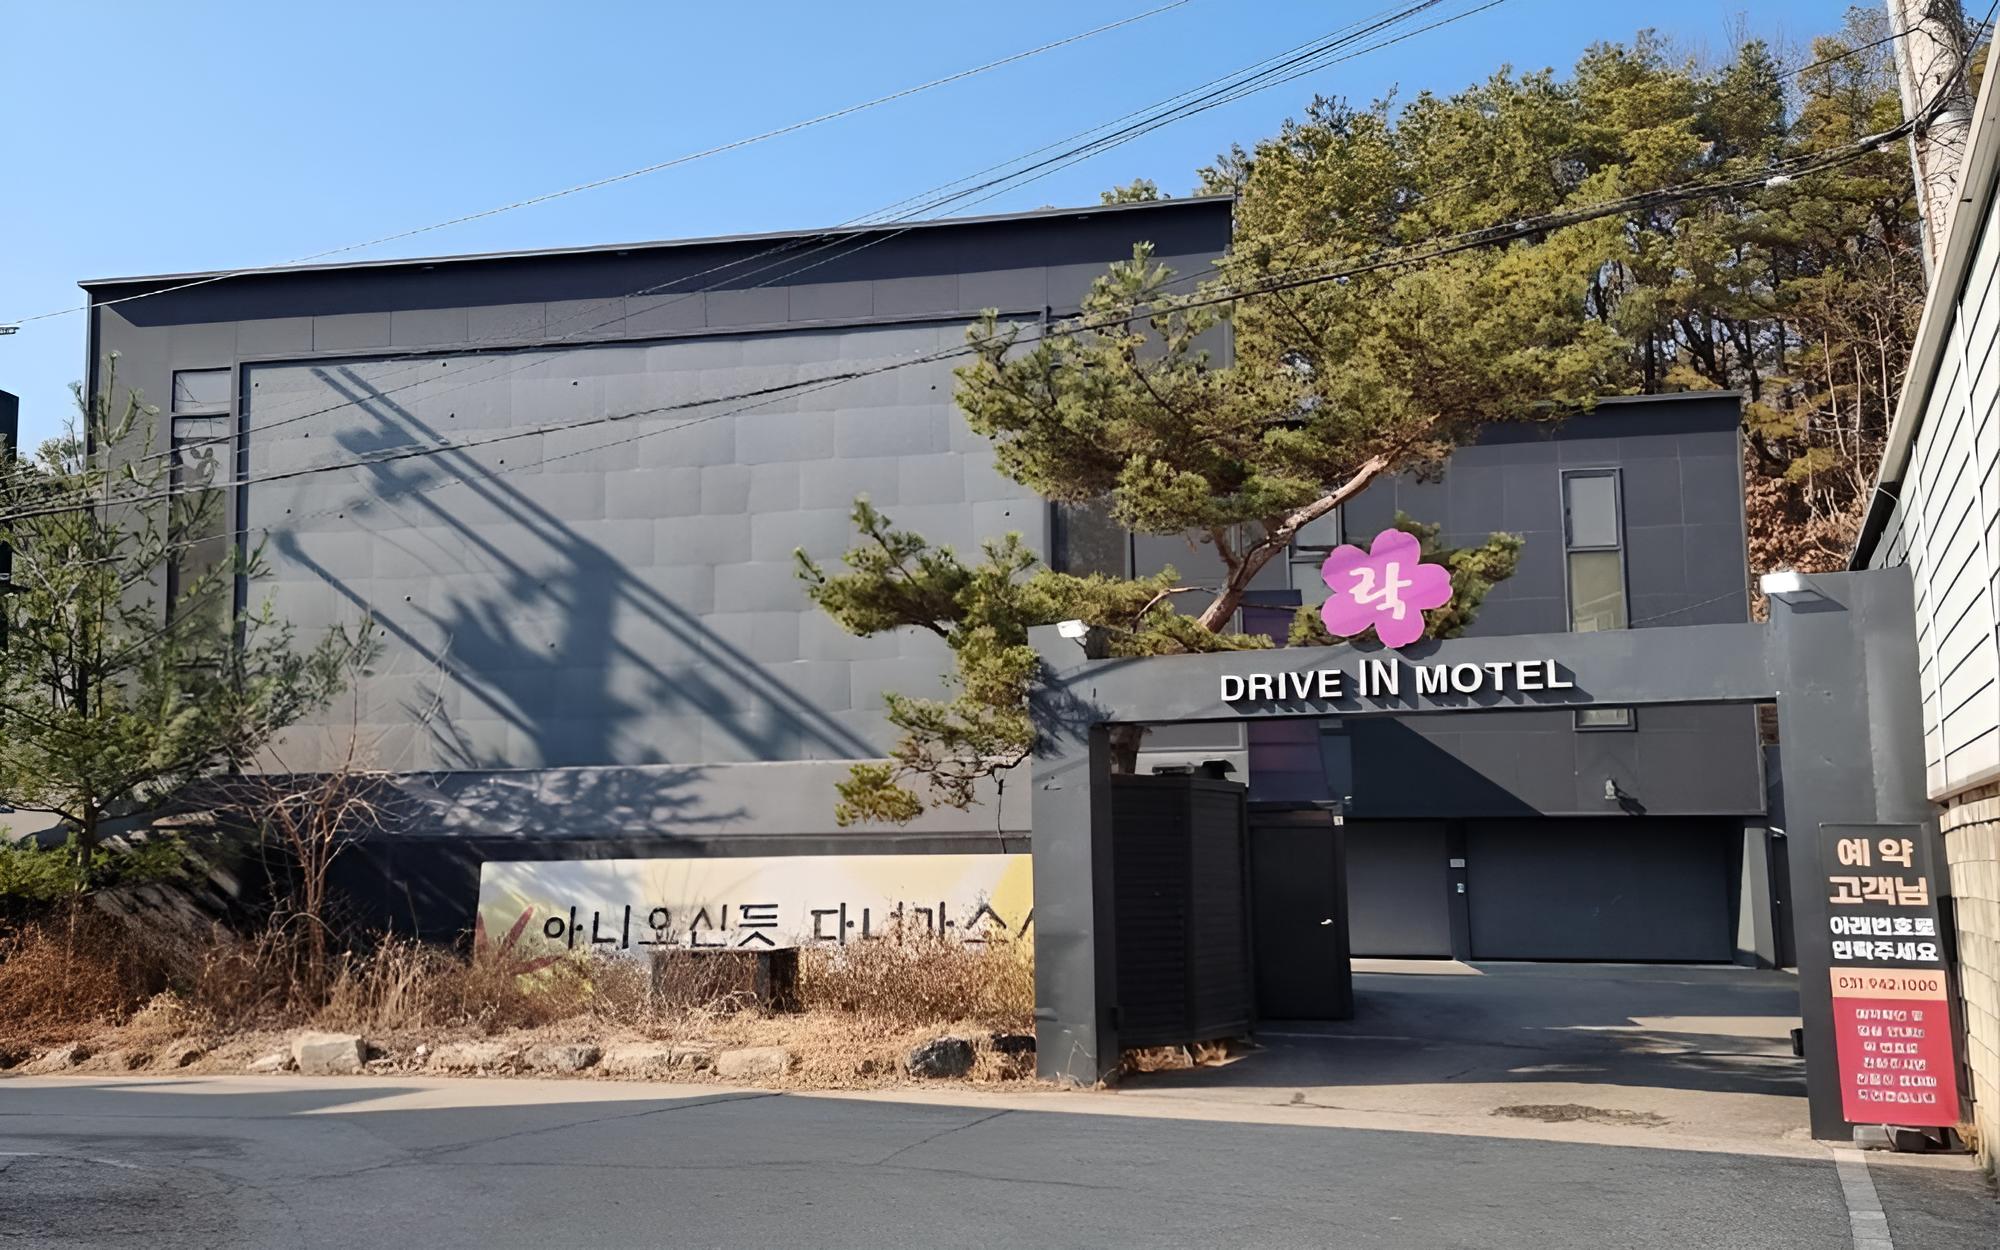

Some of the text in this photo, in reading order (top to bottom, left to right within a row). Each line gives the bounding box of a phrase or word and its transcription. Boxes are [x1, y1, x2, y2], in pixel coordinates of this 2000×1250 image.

[1349, 562, 1412, 620] 락
[1220, 658, 1573, 701] DRIVE IN MOTEL
[1829, 876, 1929, 906] 고객님
